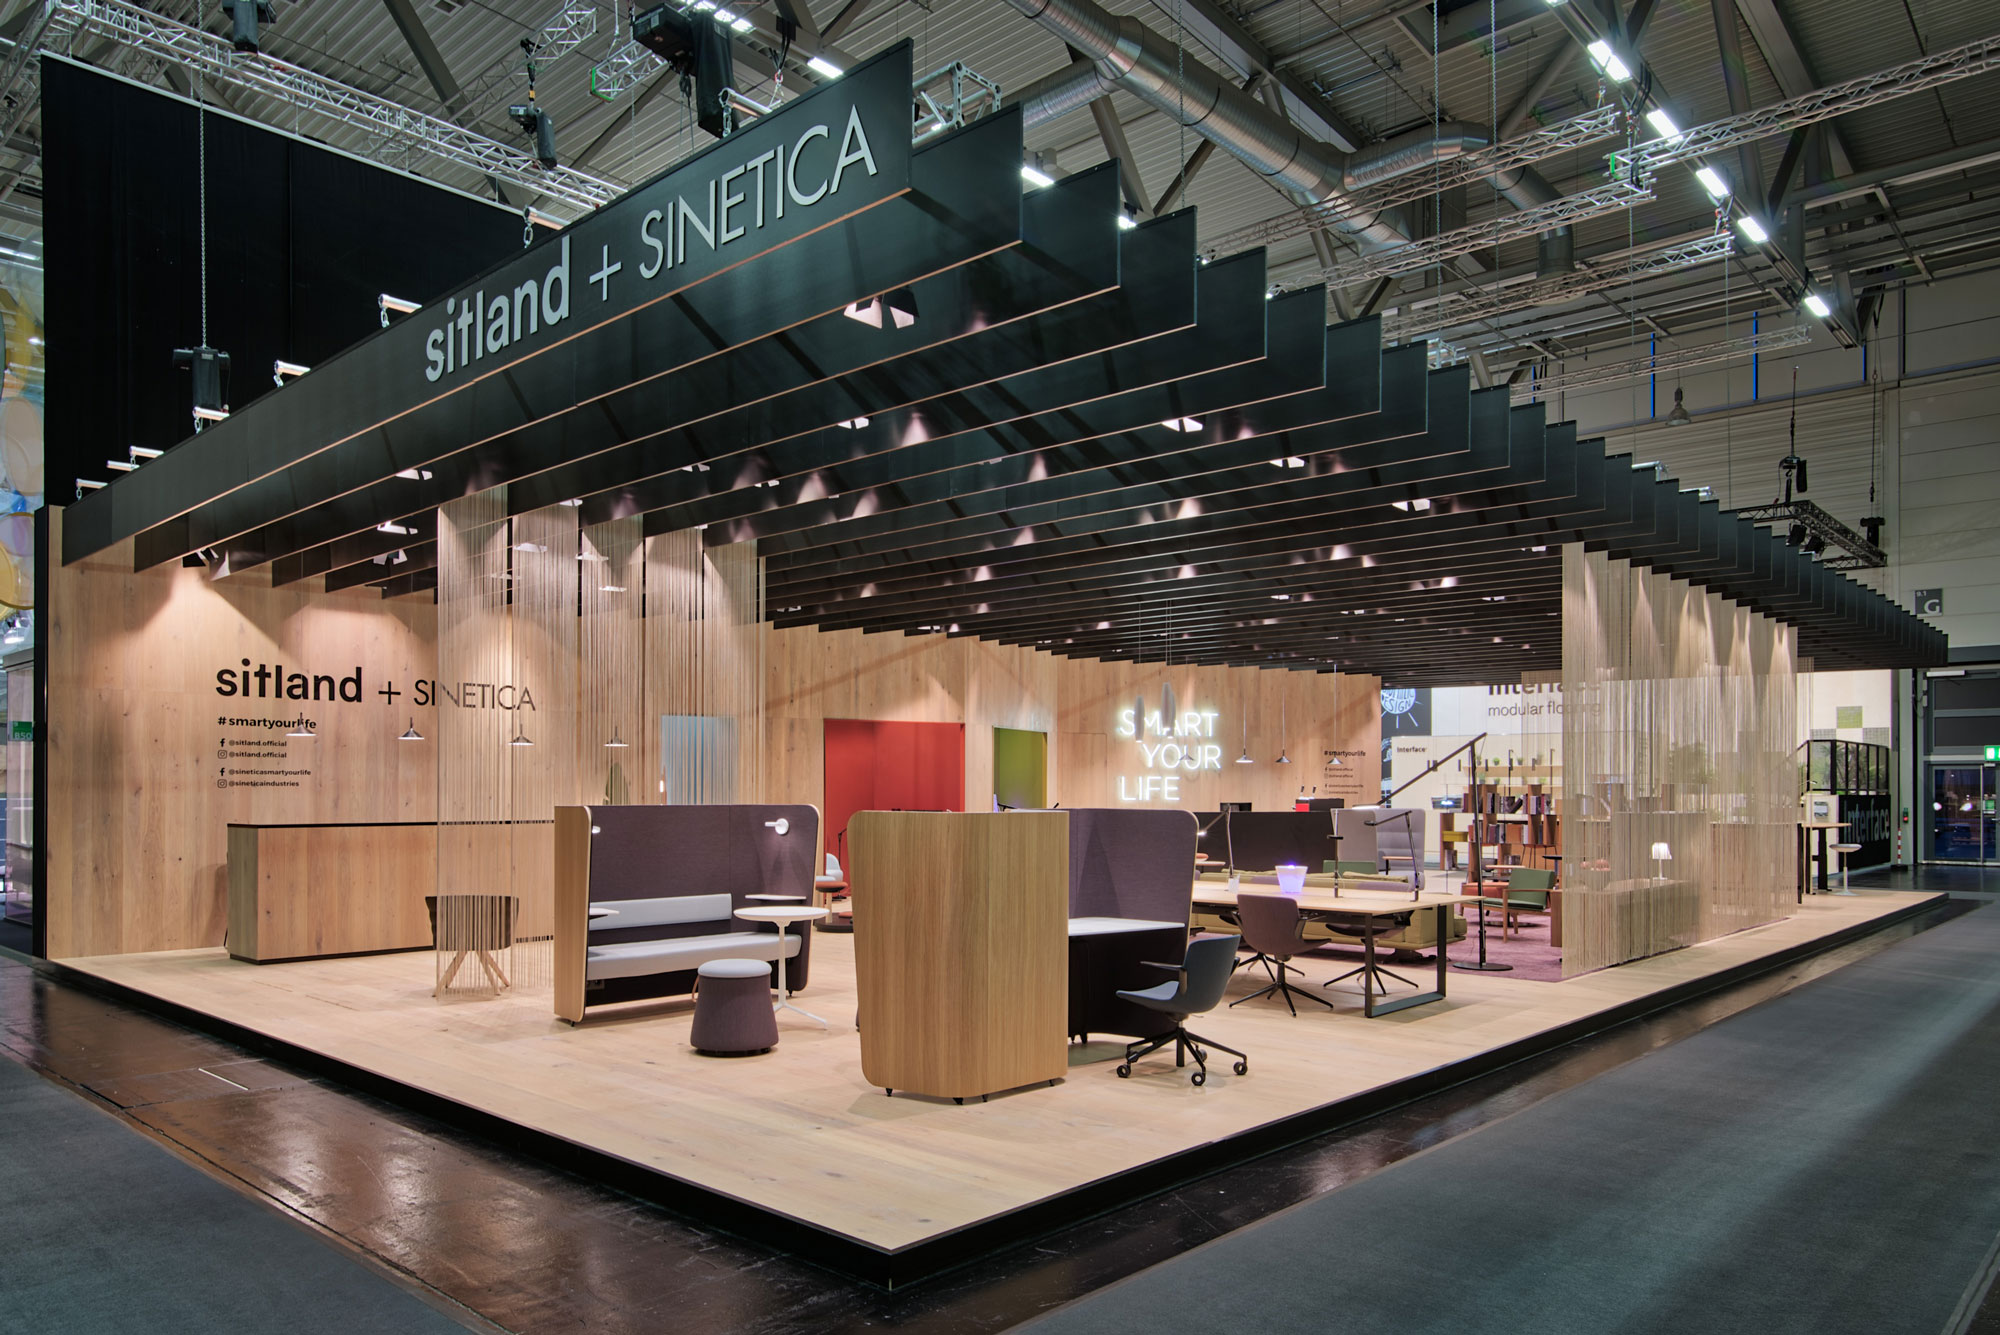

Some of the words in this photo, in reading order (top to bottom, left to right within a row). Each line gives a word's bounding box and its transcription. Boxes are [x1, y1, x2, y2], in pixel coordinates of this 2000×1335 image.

[425, 235, 571, 382] sitland
[589, 245, 622, 301] +
[639, 104, 878, 279] SINETICA
[1924, 599, 1941, 615] G
[216, 658, 362, 703] sitland
[378, 681, 401, 705] +
[413, 679, 536, 711] SINETICA
[1488, 702, 1543, 716] modular
[1142, 743, 1222, 770] YOUR
[1121, 776, 1181, 801] LIFE
[1844, 798, 1890, 843] Interface
